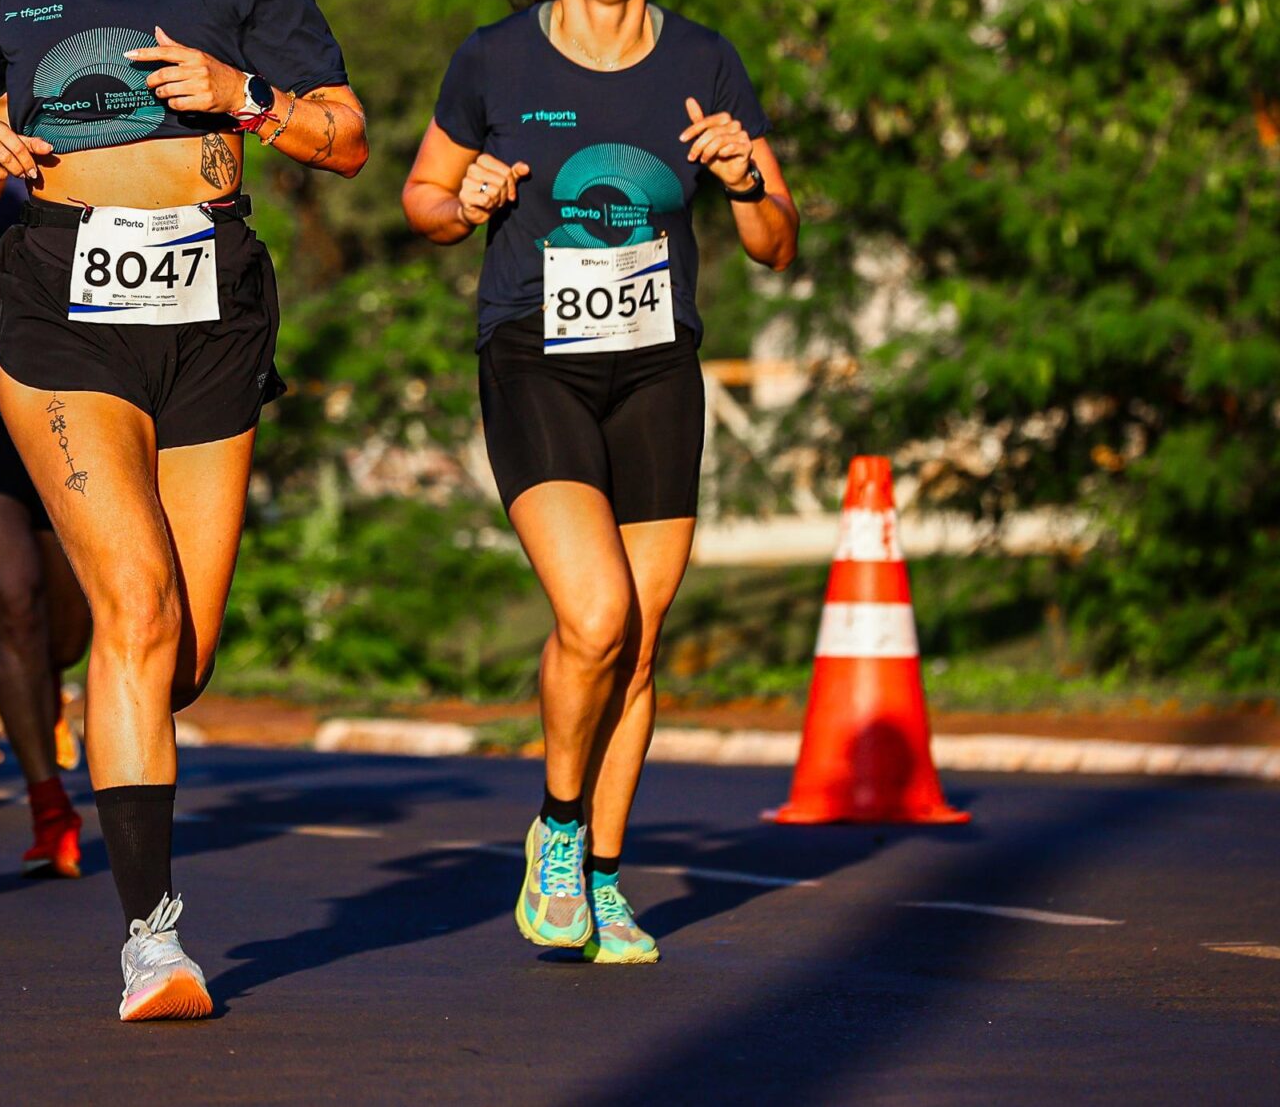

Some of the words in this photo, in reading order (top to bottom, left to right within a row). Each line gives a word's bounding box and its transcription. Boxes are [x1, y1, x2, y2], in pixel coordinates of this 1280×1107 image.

[20, 3, 64, 17] tfsports
[33, 13, 62, 22] APRESENTA
[106, 100, 156, 110] RUNNING
[535, 110, 577, 122] tfsports
[571, 206, 601, 220] Porto
[121, 218, 144, 228] Porto
[84, 247, 204, 289] 8047
[556, 278, 660, 321] 8054
